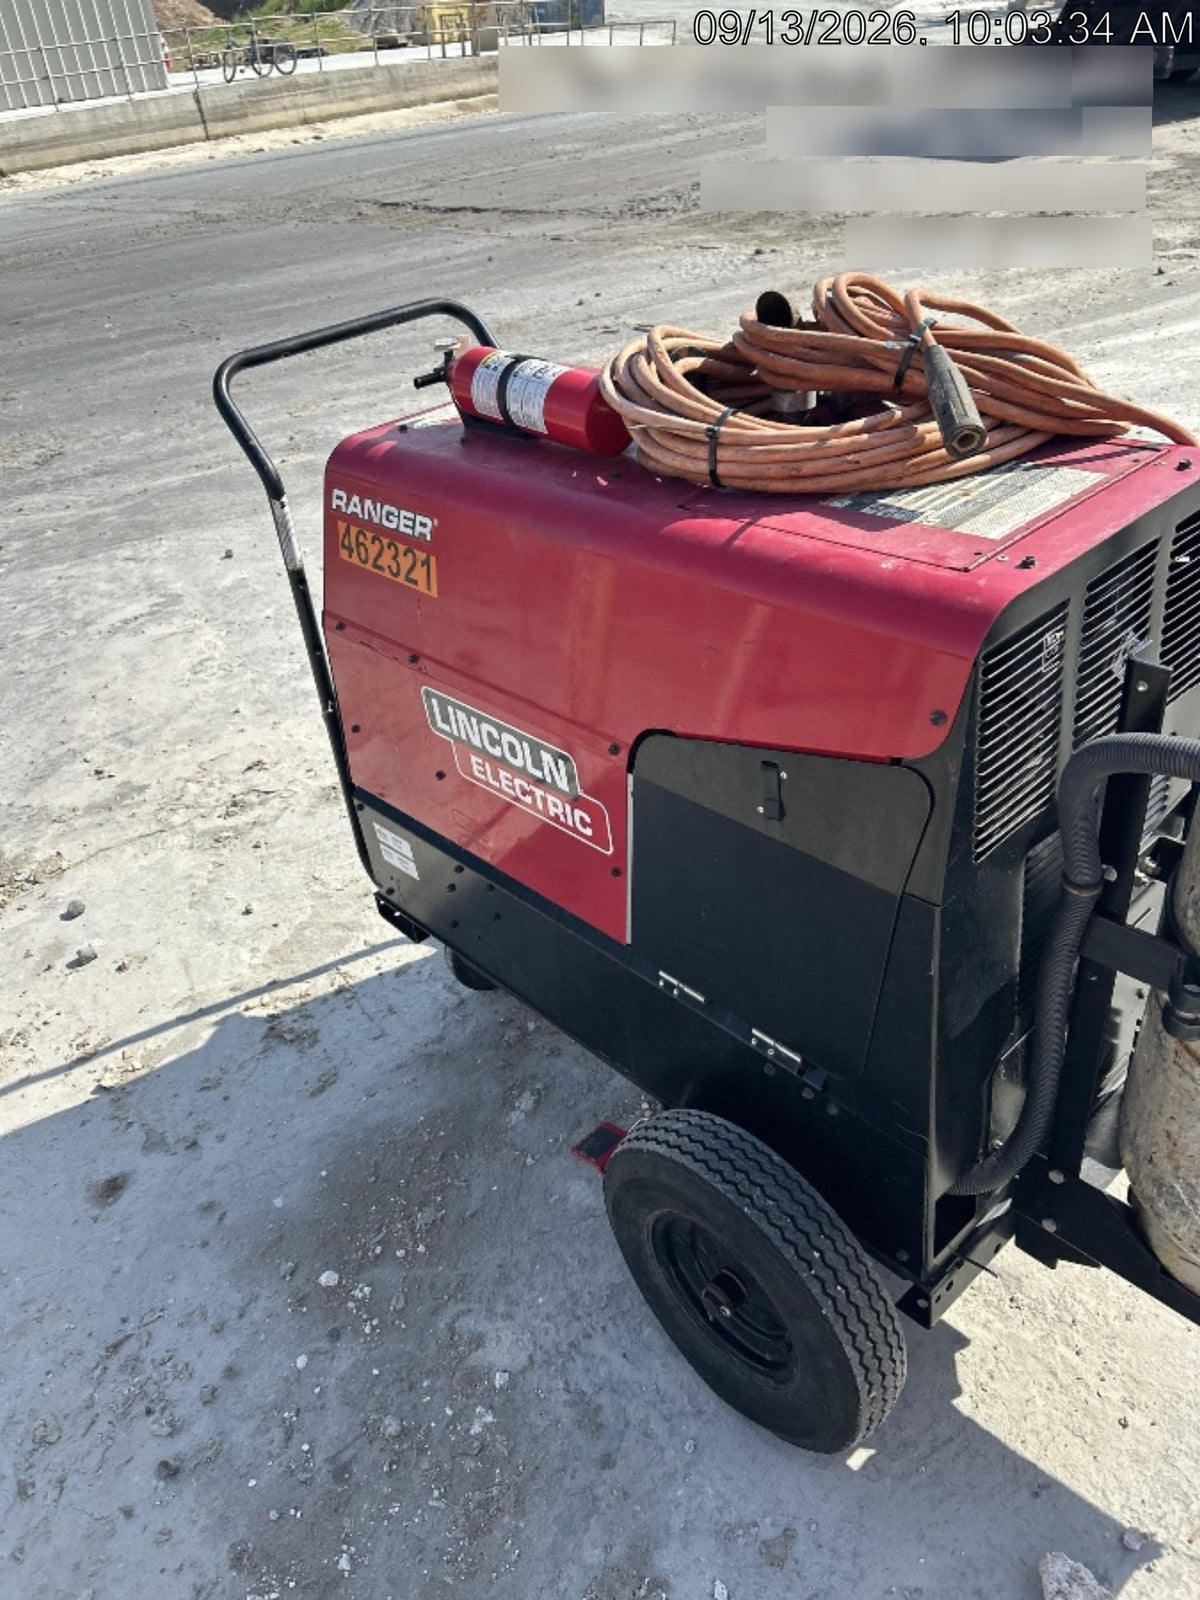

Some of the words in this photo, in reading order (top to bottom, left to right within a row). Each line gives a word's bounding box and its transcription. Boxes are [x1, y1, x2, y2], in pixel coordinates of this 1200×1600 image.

[331, 488, 433, 542] RANGER
[340, 523, 432, 592] 462321
[431, 697, 570, 793] LINCOLN
[469, 754, 593, 837] ELECTRIC
